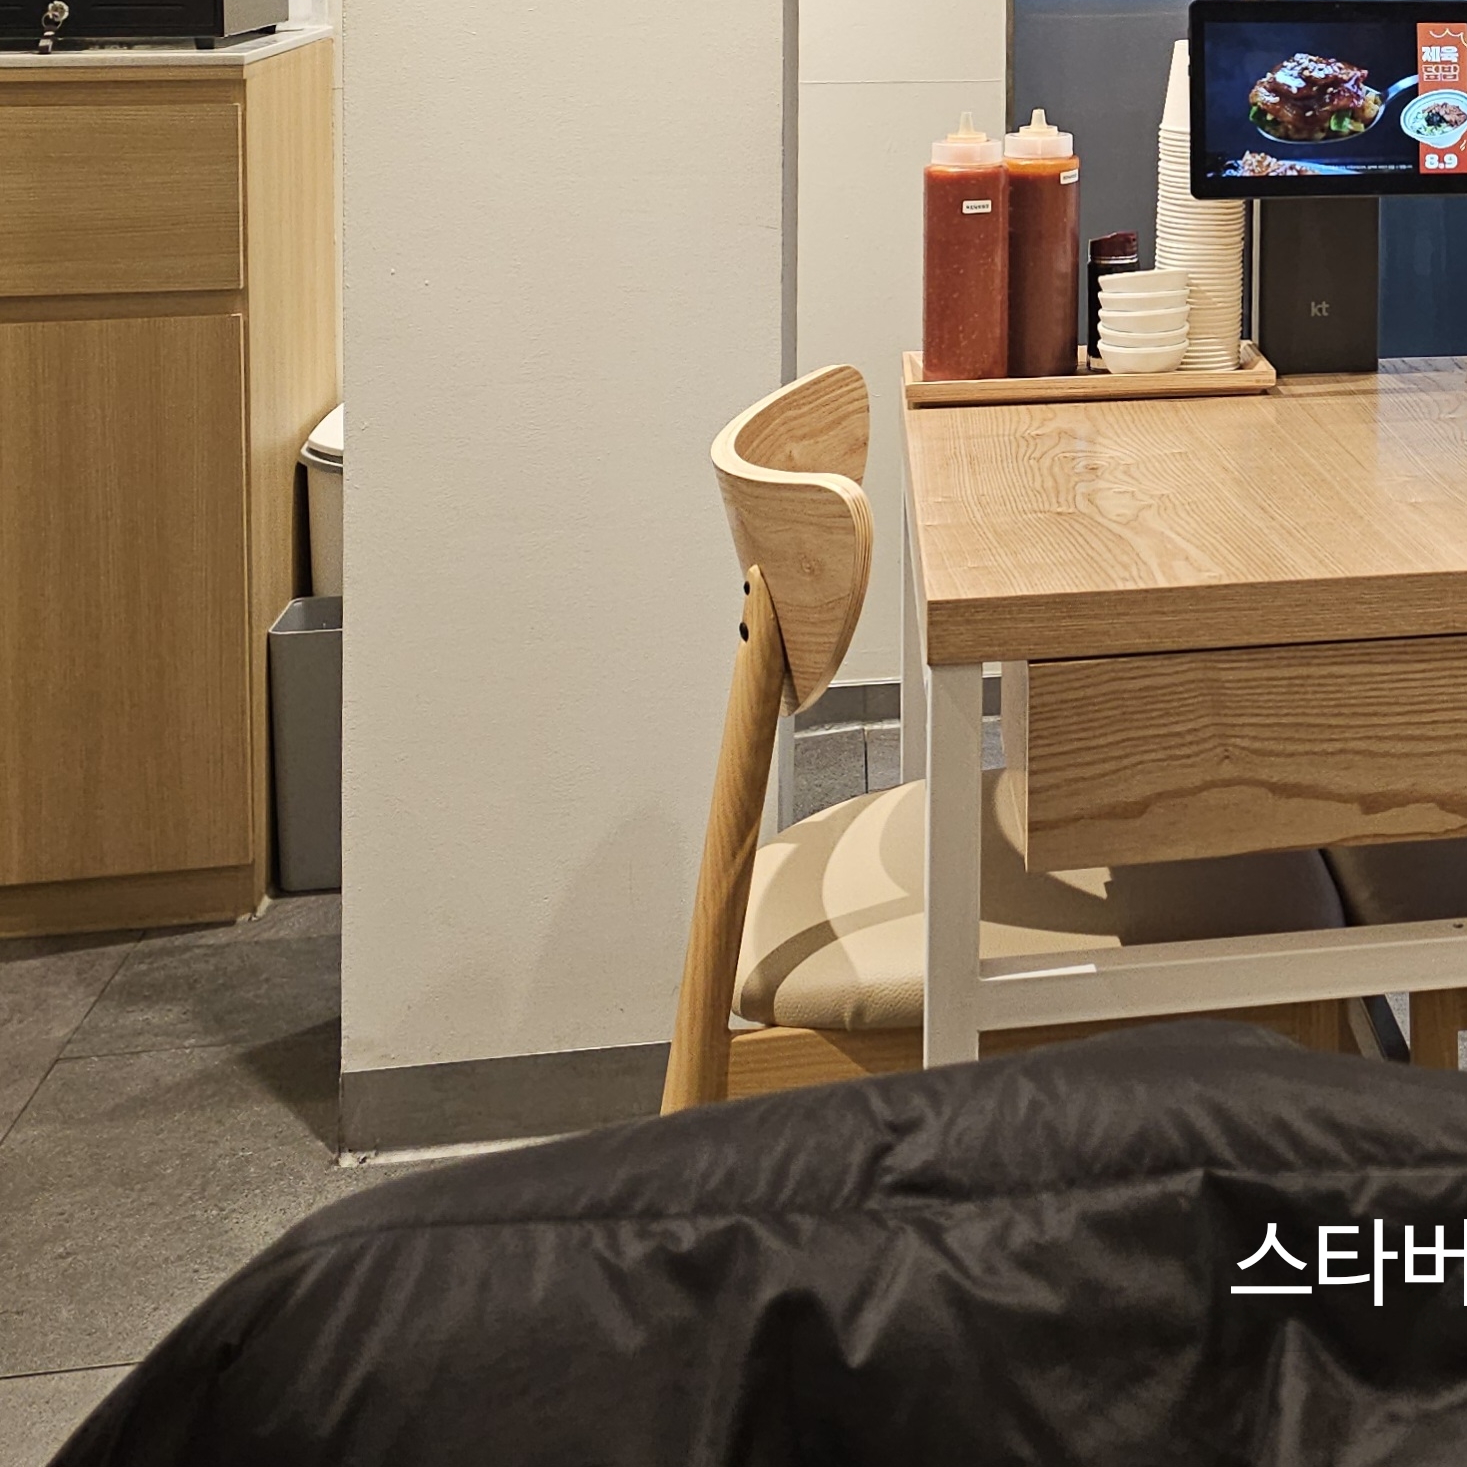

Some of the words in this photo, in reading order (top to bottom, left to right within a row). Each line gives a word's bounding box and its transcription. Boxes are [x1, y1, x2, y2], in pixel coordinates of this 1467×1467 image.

[1421, 46, 1459, 63] 제육
[1422, 65, 1460, 82] 덮밥
[1424, 153, 1458, 169] 8.9
[1311, 301, 1330, 317] kt
